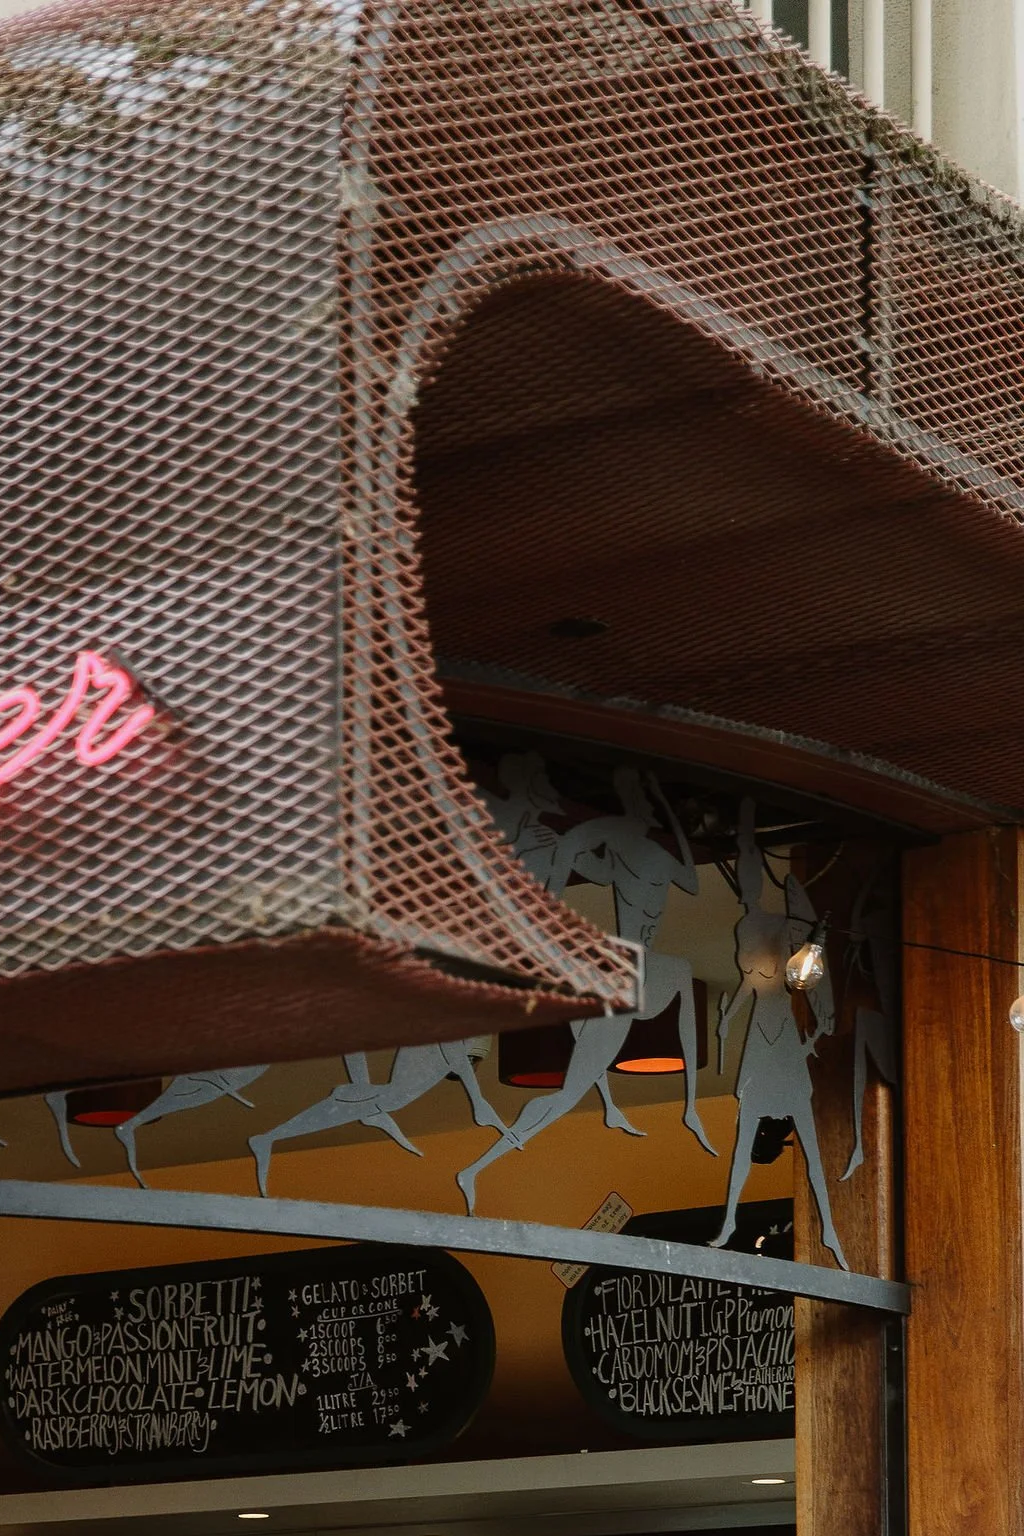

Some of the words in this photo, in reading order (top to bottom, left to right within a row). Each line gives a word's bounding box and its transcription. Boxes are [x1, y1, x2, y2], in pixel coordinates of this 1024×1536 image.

[128, 1276, 250, 1323] SORBETTI
[302, 1280, 360, 1305] GELATO
[371, 1270, 427, 1299] SORBET
[322, 1306, 347, 1319] CUP
[351, 1304, 366, 1316] OR
[369, 1298, 398, 1314] CONE
[16, 1324, 92, 1365] MANGO
[589, 1302, 698, 1353] HAZELNUT
[145, 1350, 199, 1385] MINT
[208, 1343, 267, 1381] LIME
[597, 1341, 694, 1385] CARDOMOM
[16, 1386, 72, 1419] DARK
[74, 1380, 199, 1414] CHOCOLATE
[208, 1373, 298, 1409] LEMON
[619, 1377, 672, 1416] BLACK
[671, 1372, 733, 1415] SESAME
